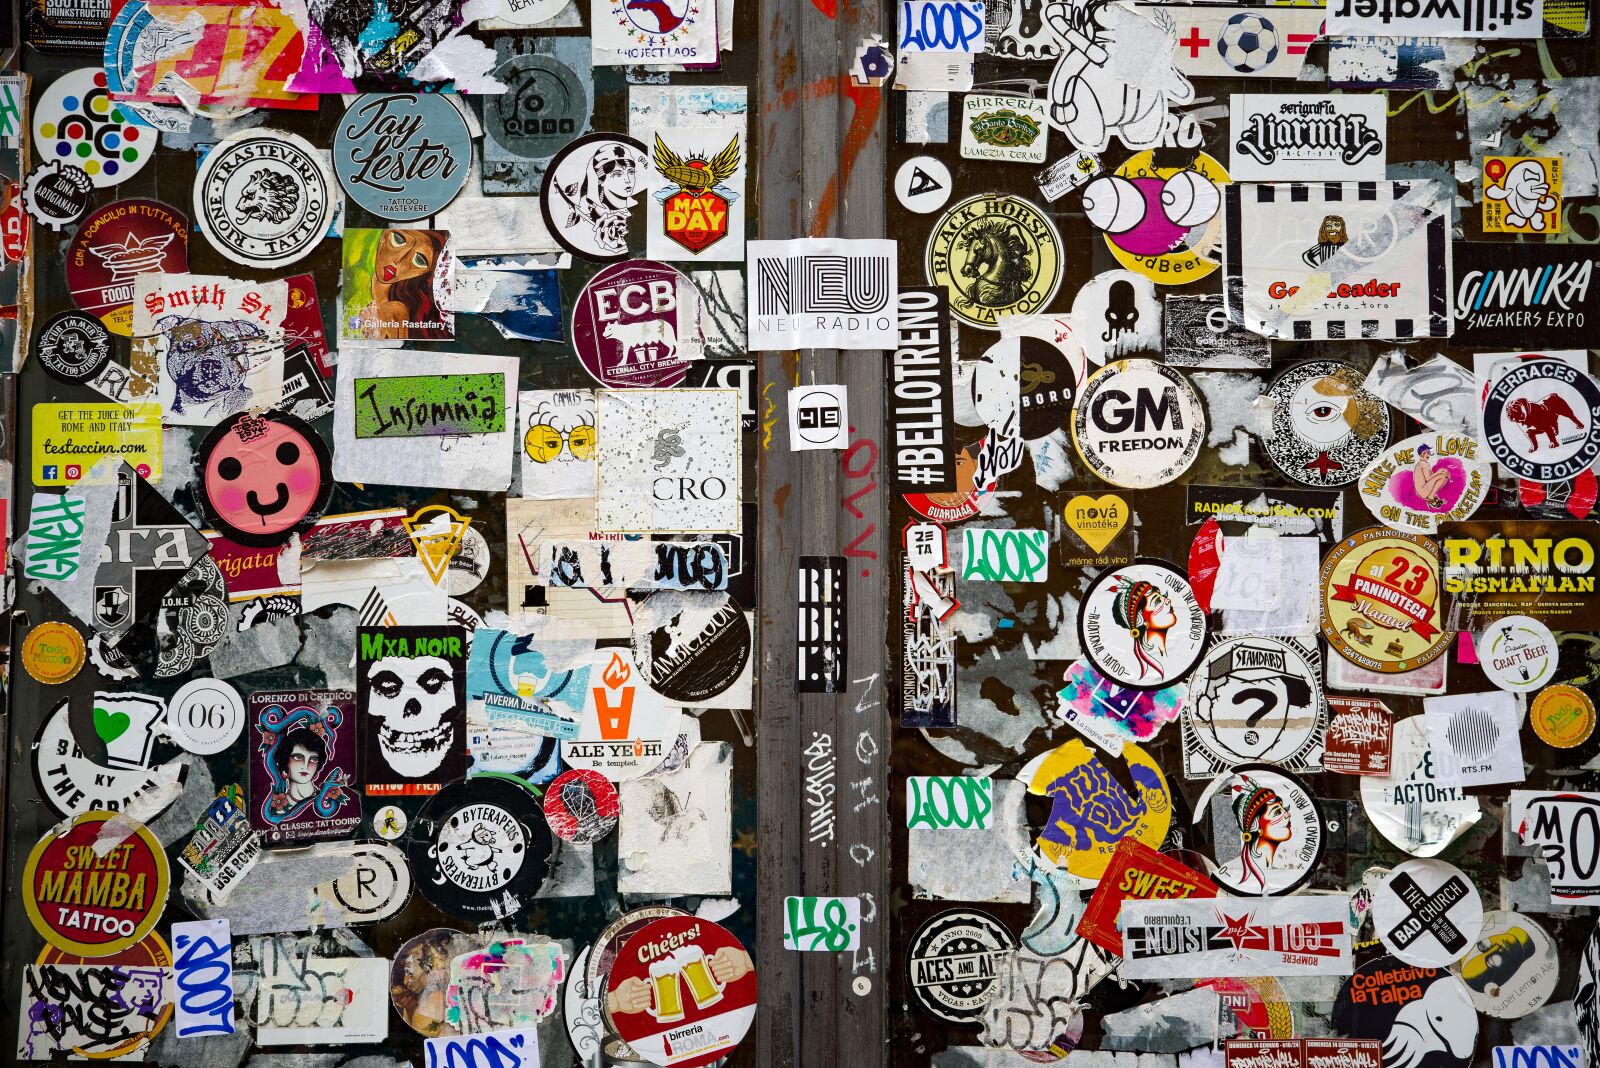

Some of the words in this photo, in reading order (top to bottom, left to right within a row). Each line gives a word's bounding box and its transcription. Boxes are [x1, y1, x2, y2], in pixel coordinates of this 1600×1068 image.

[1335, 0, 1533, 31] stillwater
[346, 94, 425, 146] Jay
[213, 145, 317, 185] TRASTEVERE
[350, 136, 459, 192] Lester
[964, 147, 1005, 158] LAMEZIA
[53, 177, 76, 197] ZONA
[35, 186, 79, 217] ARTIGIANALE
[675, 199, 715, 216] MAY
[210, 196, 248, 249] RIONE
[265, 199, 321, 254] TATTOO
[668, 212, 725, 231] DAY
[75, 248, 85, 266] CIBI
[84, 208, 126, 237] DOMICILIO
[129, 205, 138, 214] IN
[140, 206, 172, 224] TUTTA
[934, 202, 978, 274] BLACK
[984, 201, 1052, 245] HORSE
[758, 256, 889, 315] NEU
[1454, 260, 1593, 320] GINNIKA
[144, 284, 226, 316] Smith
[594, 280, 677, 320] ECB
[975, 291, 1042, 322] TATTOO
[64, 320, 96, 336] IMMER
[364, 320, 400, 329] Galleria
[402, 319, 446, 331] Rastafary
[758, 318, 800, 332] NEU
[816, 316, 890, 331] RADIO
[1468, 313, 1542, 330] SNEAKERS
[1546, 312, 1585, 328] EXPO
[53, 358, 78, 374] TATTOO
[80, 352, 98, 372] STUDIO
[606, 366, 638, 376] ETERNAL
[640, 363, 655, 371] CITY
[894, 291, 945, 485] #BELLOTRENO
[1491, 364, 1578, 402] TERRACES
[58, 410, 74, 420] GET
[78, 410, 93, 420] THE
[98, 410, 120, 420] JUICE
[123, 410, 135, 419] ON
[359, 384, 496, 435] Insomnia
[1092, 386, 1184, 434] GM
[62, 422, 84, 432] ROME
[89, 422, 106, 432] AND
[110, 422, 132, 432] ITALY
[1098, 437, 1184, 453] FREEDOM
[1488, 433, 1534, 478] DOG'S
[1540, 406, 1600, 480] BOLLOCKS
[1362, 460, 1396, 497] MAKE
[1394, 448, 1416, 466] ME
[1436, 436, 1478, 460] LOVE
[1076, 504, 1118, 520] nová
[1077, 519, 1118, 529] vinotéka
[1381, 505, 1402, 522] ON
[1405, 512, 1430, 529] THE
[1444, 538, 1594, 574] RINO
[1165, 574, 1186, 594] PRATO
[1370, 565, 1385, 578] al
[1384, 556, 1430, 596] 23
[1445, 576, 1595, 593] SISMAMAN
[1354, 578, 1428, 620] PANINOTECA
[1188, 604, 1206, 641] GIORDANO
[1352, 600, 1413, 632] Manuel
[1088, 612, 1105, 657] TRADITIONAL
[1102, 652, 1125, 676] TATTOO
[1236, 650, 1283, 670] STANDARD
[1492, 654, 1522, 671] CRAFT
[1523, 644, 1549, 661] BEER
[252, 694, 296, 704] LORENZO
[310, 692, 352, 702] CREDICO
[188, 703, 225, 730] 06
[568, 745, 604, 758] ALE
[592, 760, 603, 768] Be
[606, 760, 638, 768] tempted.
[95, 774, 116, 788] KY
[1461, 764, 1492, 774] RTS.FM
[48, 764, 86, 810] THE
[1290, 790, 1310, 810] PRATO
[280, 822, 314, 830] CLASSIC
[316, 816, 362, 828] TATTOOING
[462, 806, 520, 842] BYTERAPERS
[1304, 809, 1317, 824] DAL
[63, 844, 136, 870] SWEET
[1300, 826, 1318, 862] GIORDANO
[443, 854, 499, 890] BYTERAPERS
[1118, 868, 1197, 900] SWEET
[39, 870, 148, 912] MAMBA
[1402, 884, 1424, 908] THE
[58, 908, 136, 938] TATTOO
[1144, 915, 1191, 926] L'EQUILIBRIO
[1395, 918, 1422, 944] BAD
[1418, 880, 1462, 924] CHURCH
[638, 924, 702, 964] Cheers!
[940, 930, 963, 944] ANNO
[1438, 930, 1452, 945] TRUST
[1440, 923, 1458, 940] TATTOO
[918, 958, 954, 984] ACES
[958, 961, 974, 974] AND
[1282, 954, 1318, 966] ROMPERE
[1352, 966, 1437, 989] Collettivo
[1492, 994, 1516, 1014] Super
[1514, 975, 1541, 1000] Lemon
[1540, 960, 1556, 977] Ale
[938, 990, 964, 1007] VEGAS
[668, 1025, 703, 1041] birreria
[672, 1032, 718, 1055] ROMA
